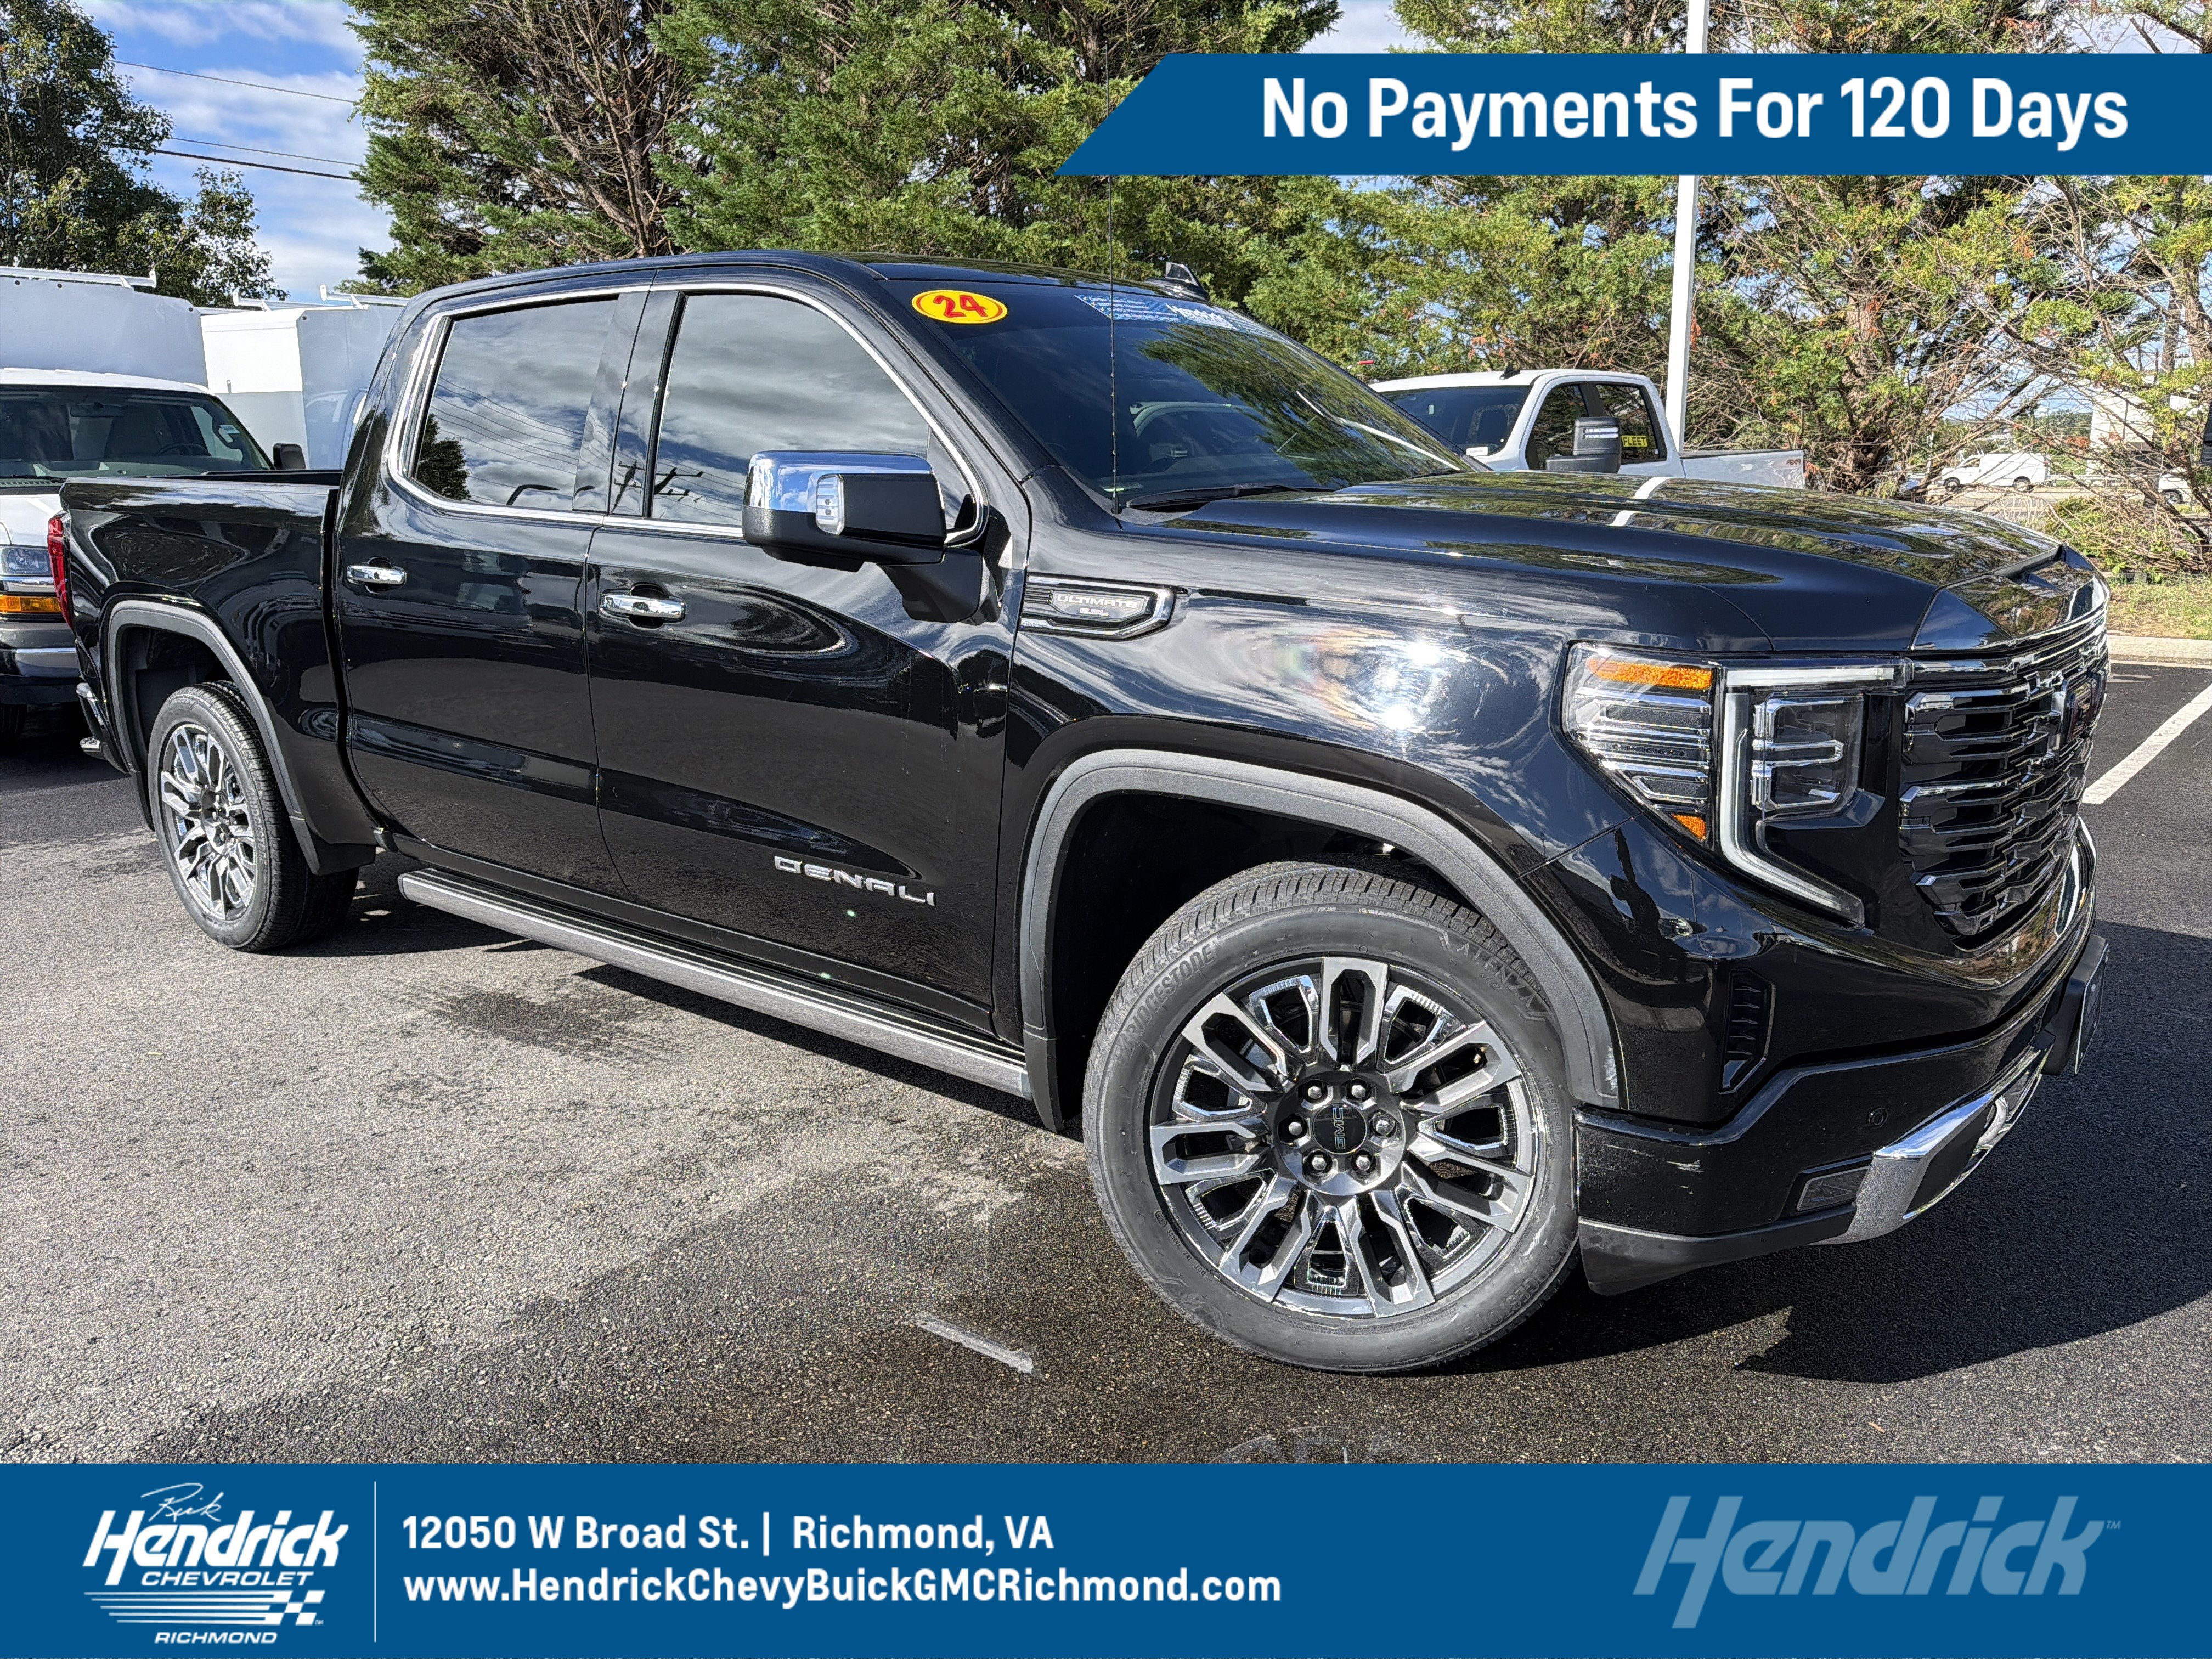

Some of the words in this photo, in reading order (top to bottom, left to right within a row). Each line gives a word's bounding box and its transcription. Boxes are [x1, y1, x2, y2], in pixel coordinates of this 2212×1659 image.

[932, 294, 989, 318] 24
[1623, 436, 1646, 445] FLEET
[1057, 594, 1139, 608] ULTIMATE
[774, 856, 936, 907] DENALI
[1332, 1107, 1346, 1150] GMC
